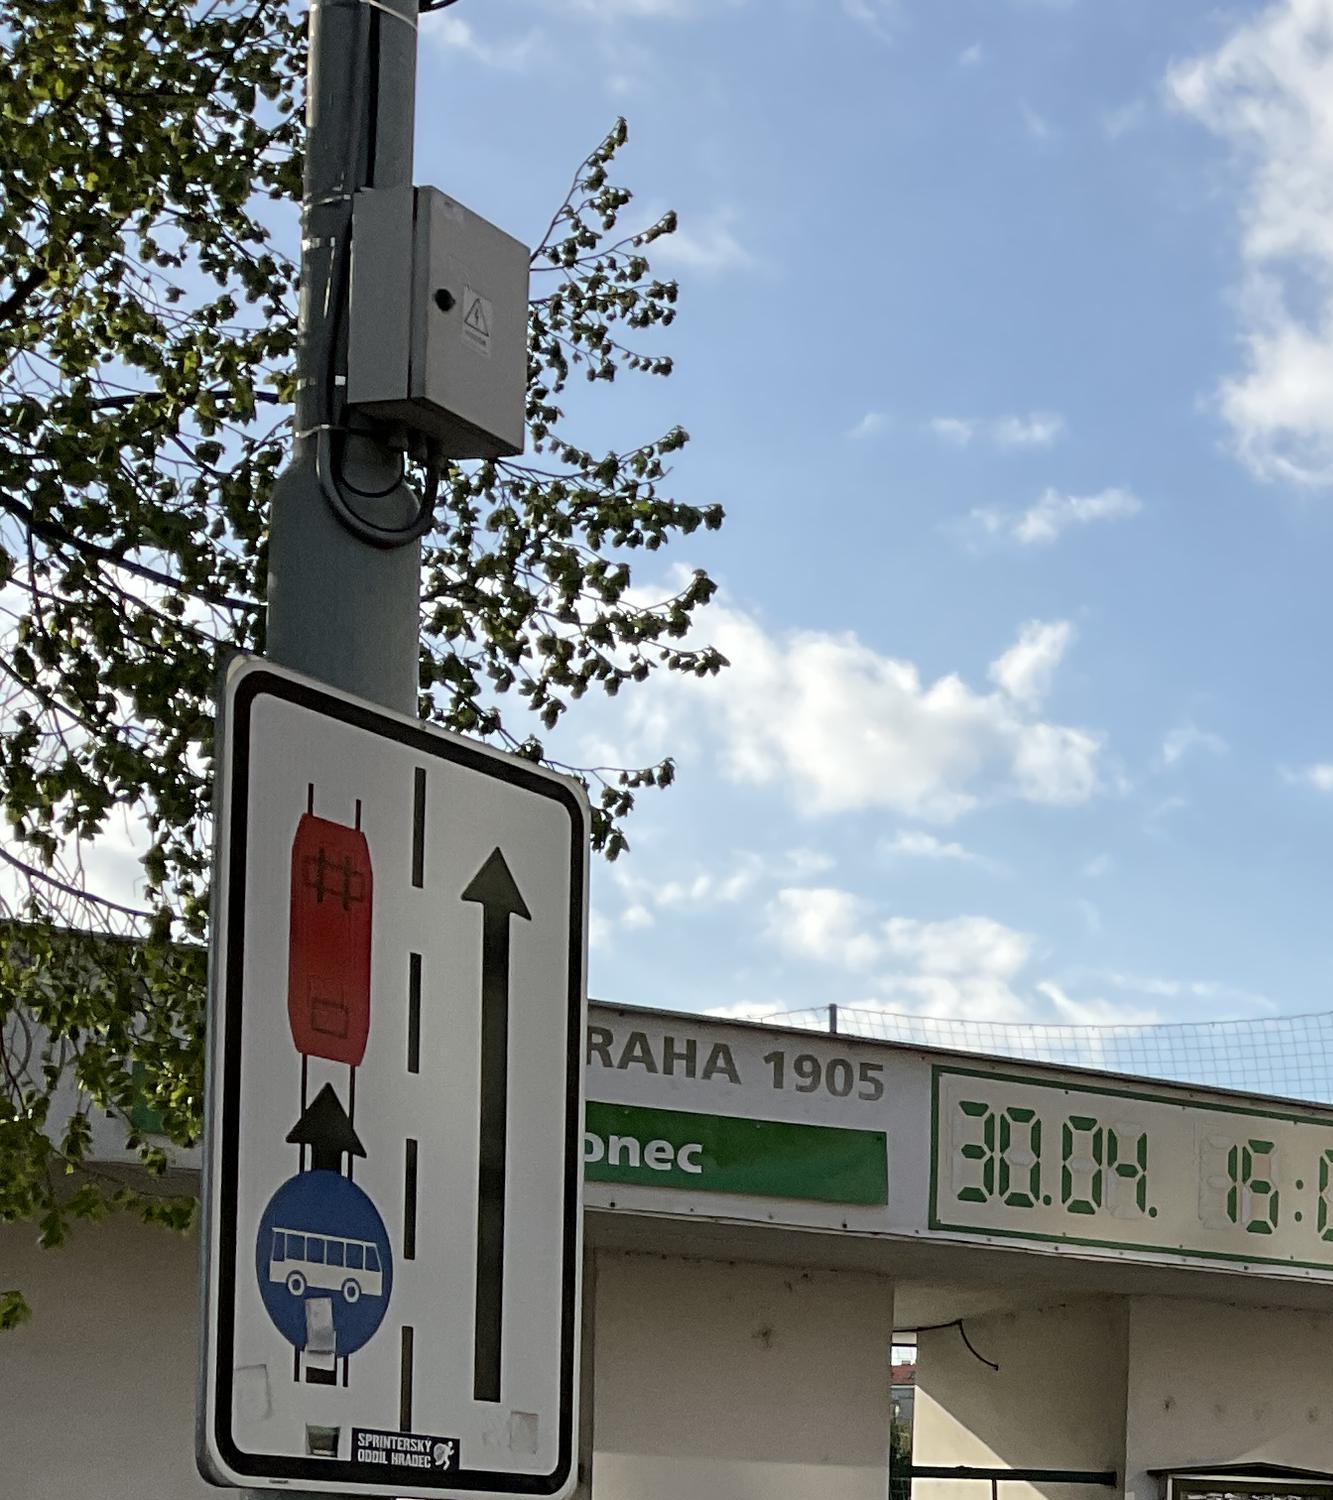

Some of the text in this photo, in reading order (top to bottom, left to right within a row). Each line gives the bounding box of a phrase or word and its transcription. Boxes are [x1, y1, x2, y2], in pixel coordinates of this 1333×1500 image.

[763, 1050, 885, 1102] 1905
[956, 1100, 1158, 1219] 30.04.
[357, 1432, 433, 1453] SPRINTERSKÝ
[357, 1448, 432, 1468] ODDÍL HRADEC
